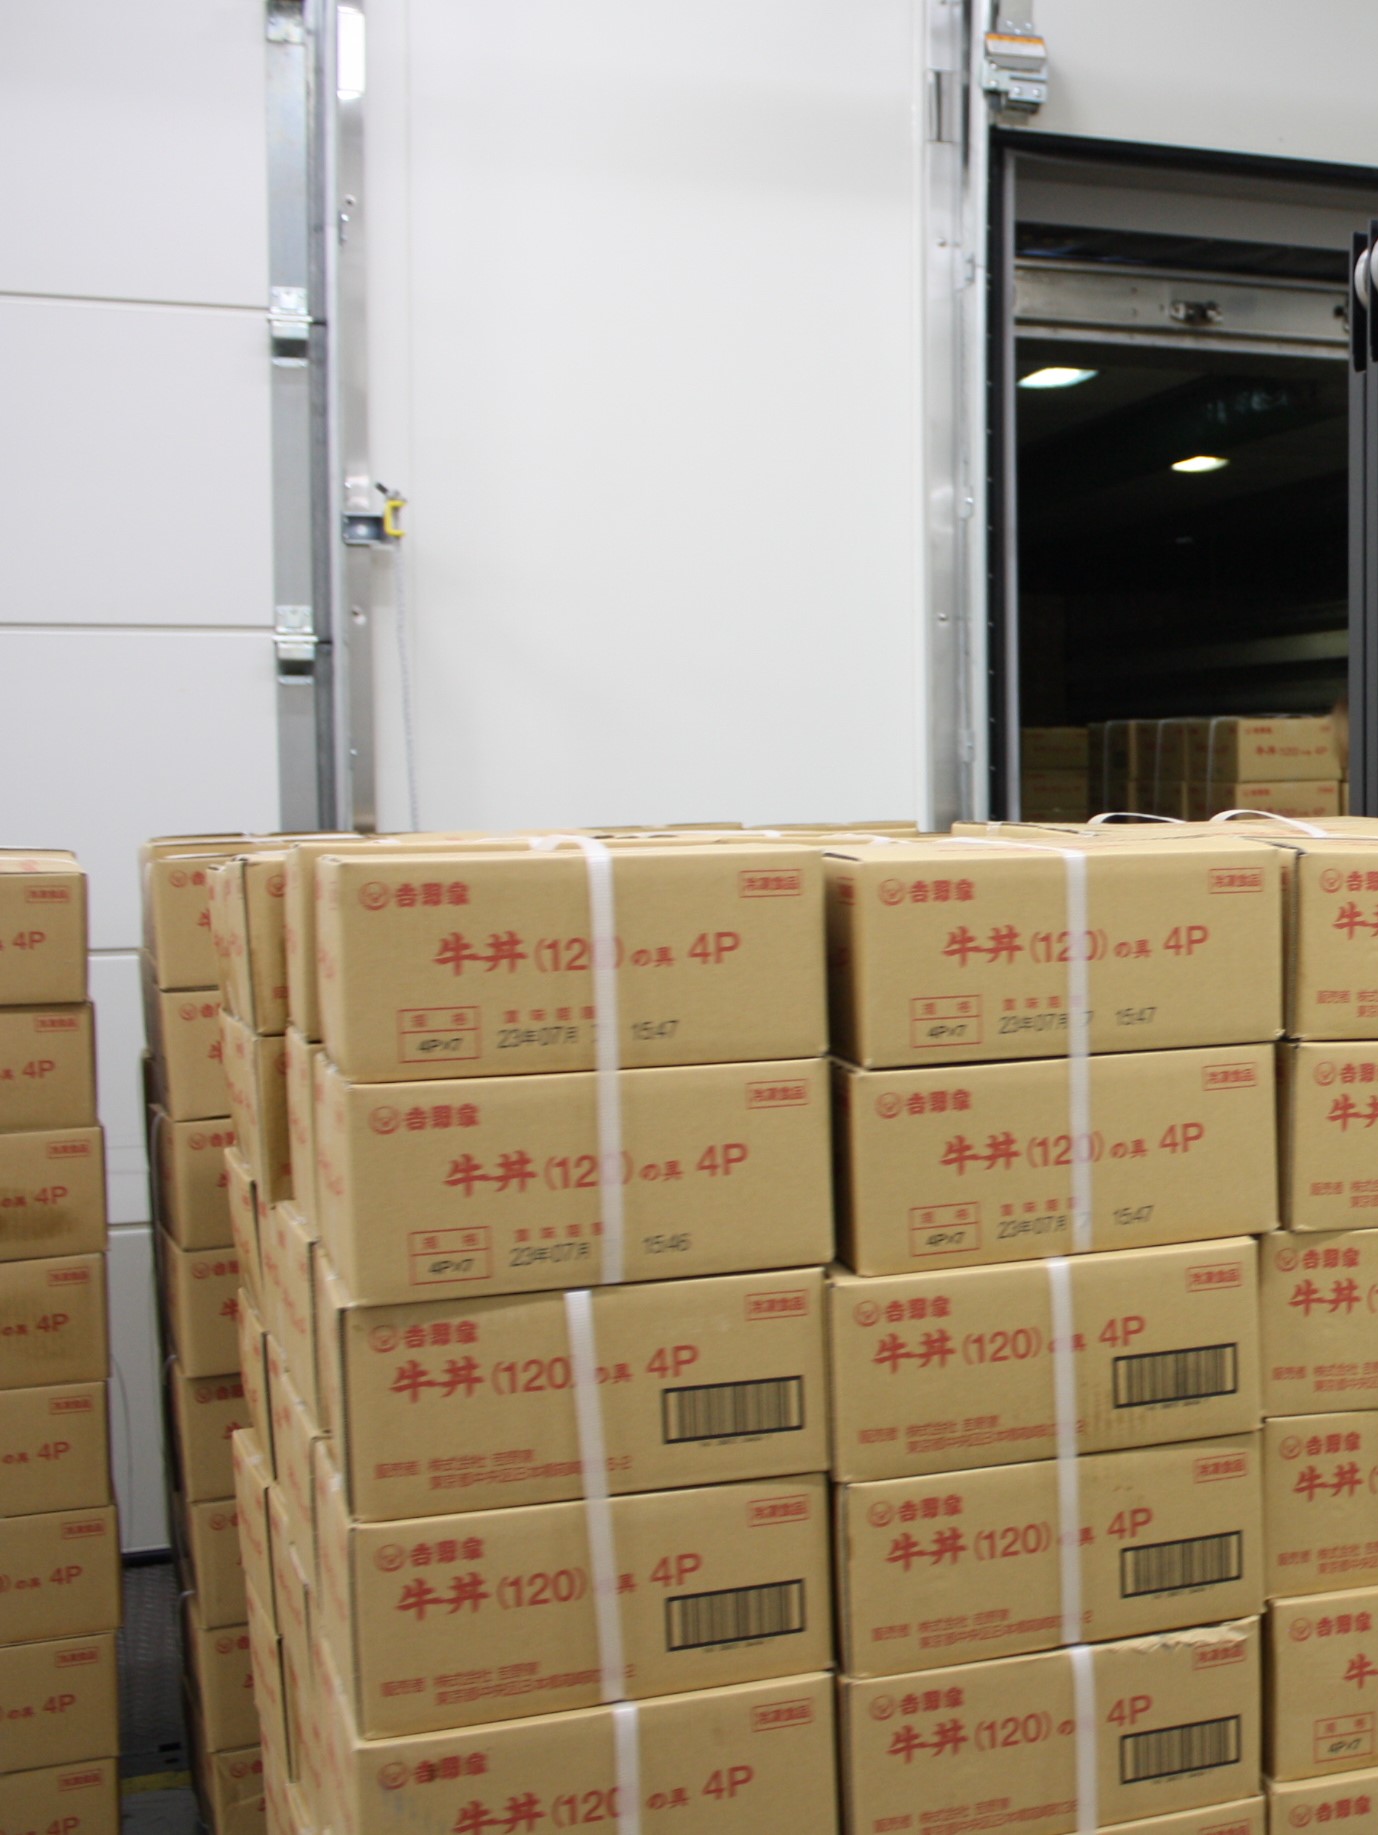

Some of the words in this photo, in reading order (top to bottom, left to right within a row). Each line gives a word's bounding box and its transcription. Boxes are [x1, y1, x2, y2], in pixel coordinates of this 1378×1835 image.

[688, 932, 741, 964] 4P
[1164, 925, 1210, 955] 4P
[23, 1059, 55, 1078] 4P
[1159, 1122, 1205, 1152] 4P
[696, 1142, 749, 1177] 4P
[35, 1186, 69, 1204] 4P
[36, 1312, 70, 1333] 4P
[1099, 1315, 1146, 1346] 4P
[646, 1344, 699, 1378] 4P
[37, 1441, 71, 1460] 4P
[1107, 1507, 1153, 1538] 4P
[49, 1565, 83, 1584] 4P
[650, 1553, 703, 1585] 4P
[44, 1693, 77, 1712] 4P
[1108, 1695, 1152, 1727] 4P
[703, 1765, 755, 1799] 4P
